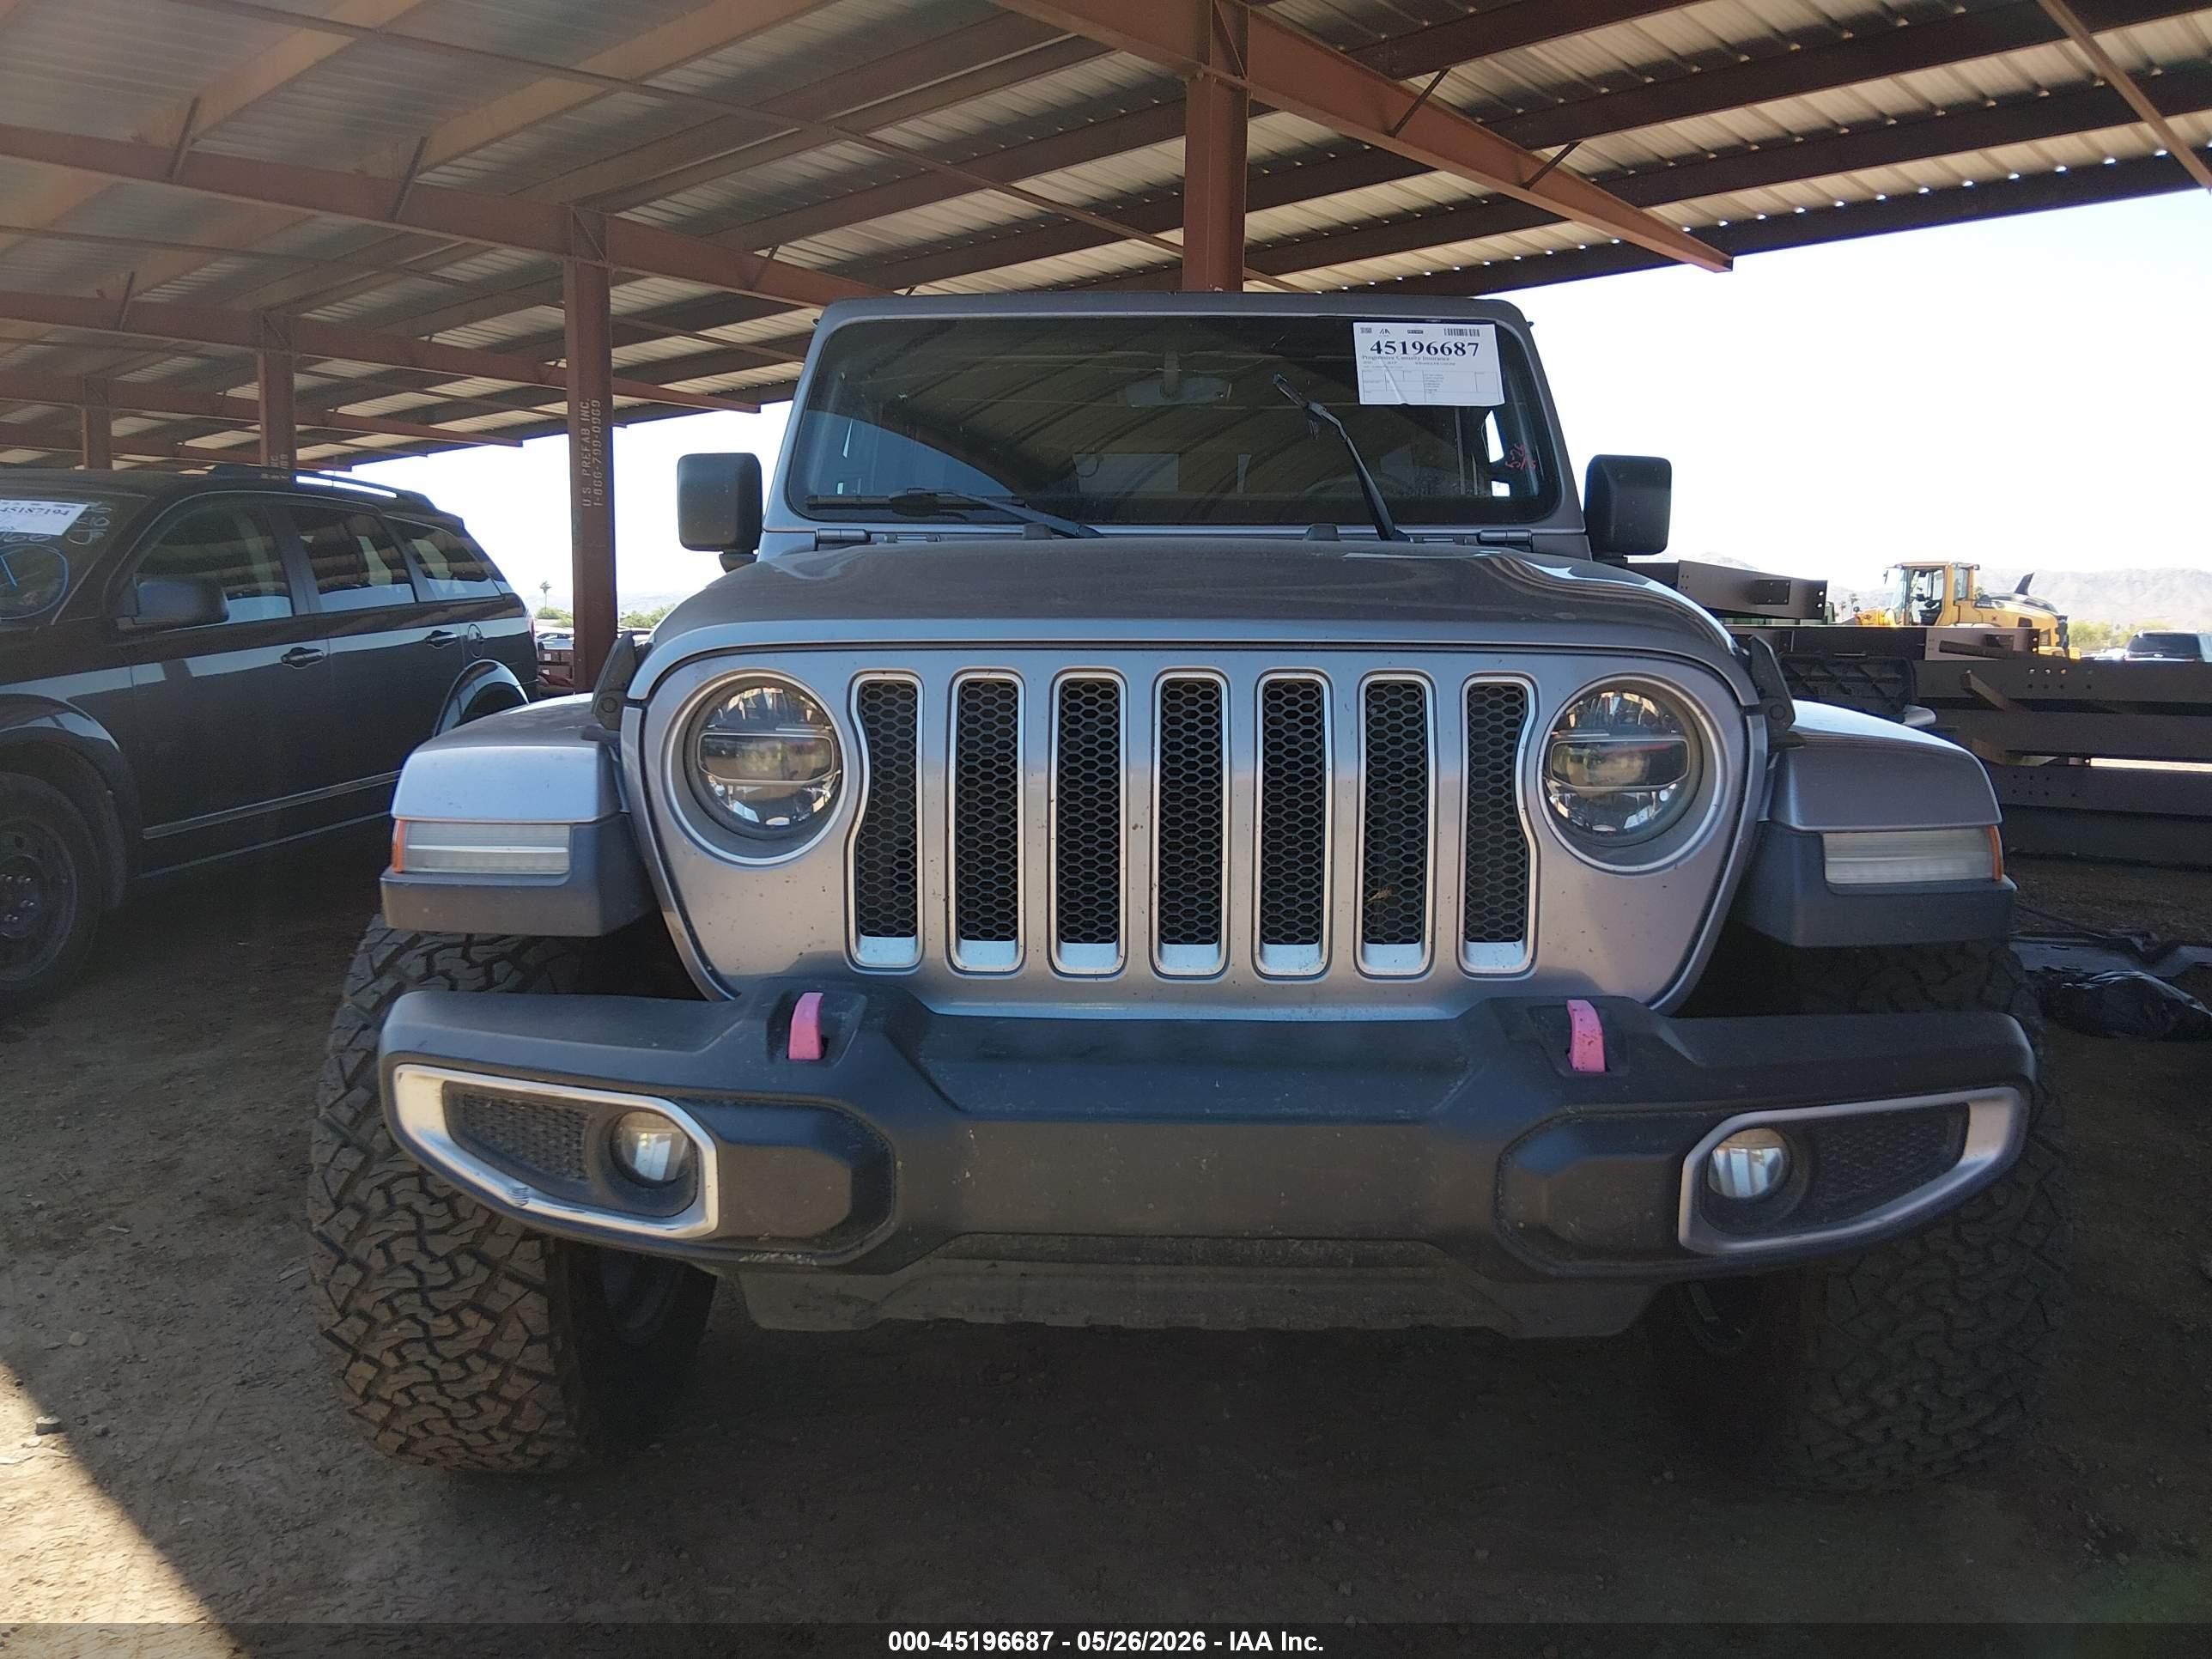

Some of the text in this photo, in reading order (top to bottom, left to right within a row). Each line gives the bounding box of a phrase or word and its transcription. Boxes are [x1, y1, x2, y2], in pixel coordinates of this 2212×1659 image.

[1370, 340, 1480, 357] 45196687
[580, 398, 591, 422] INC.
[581, 428, 592, 477] PREFAB
